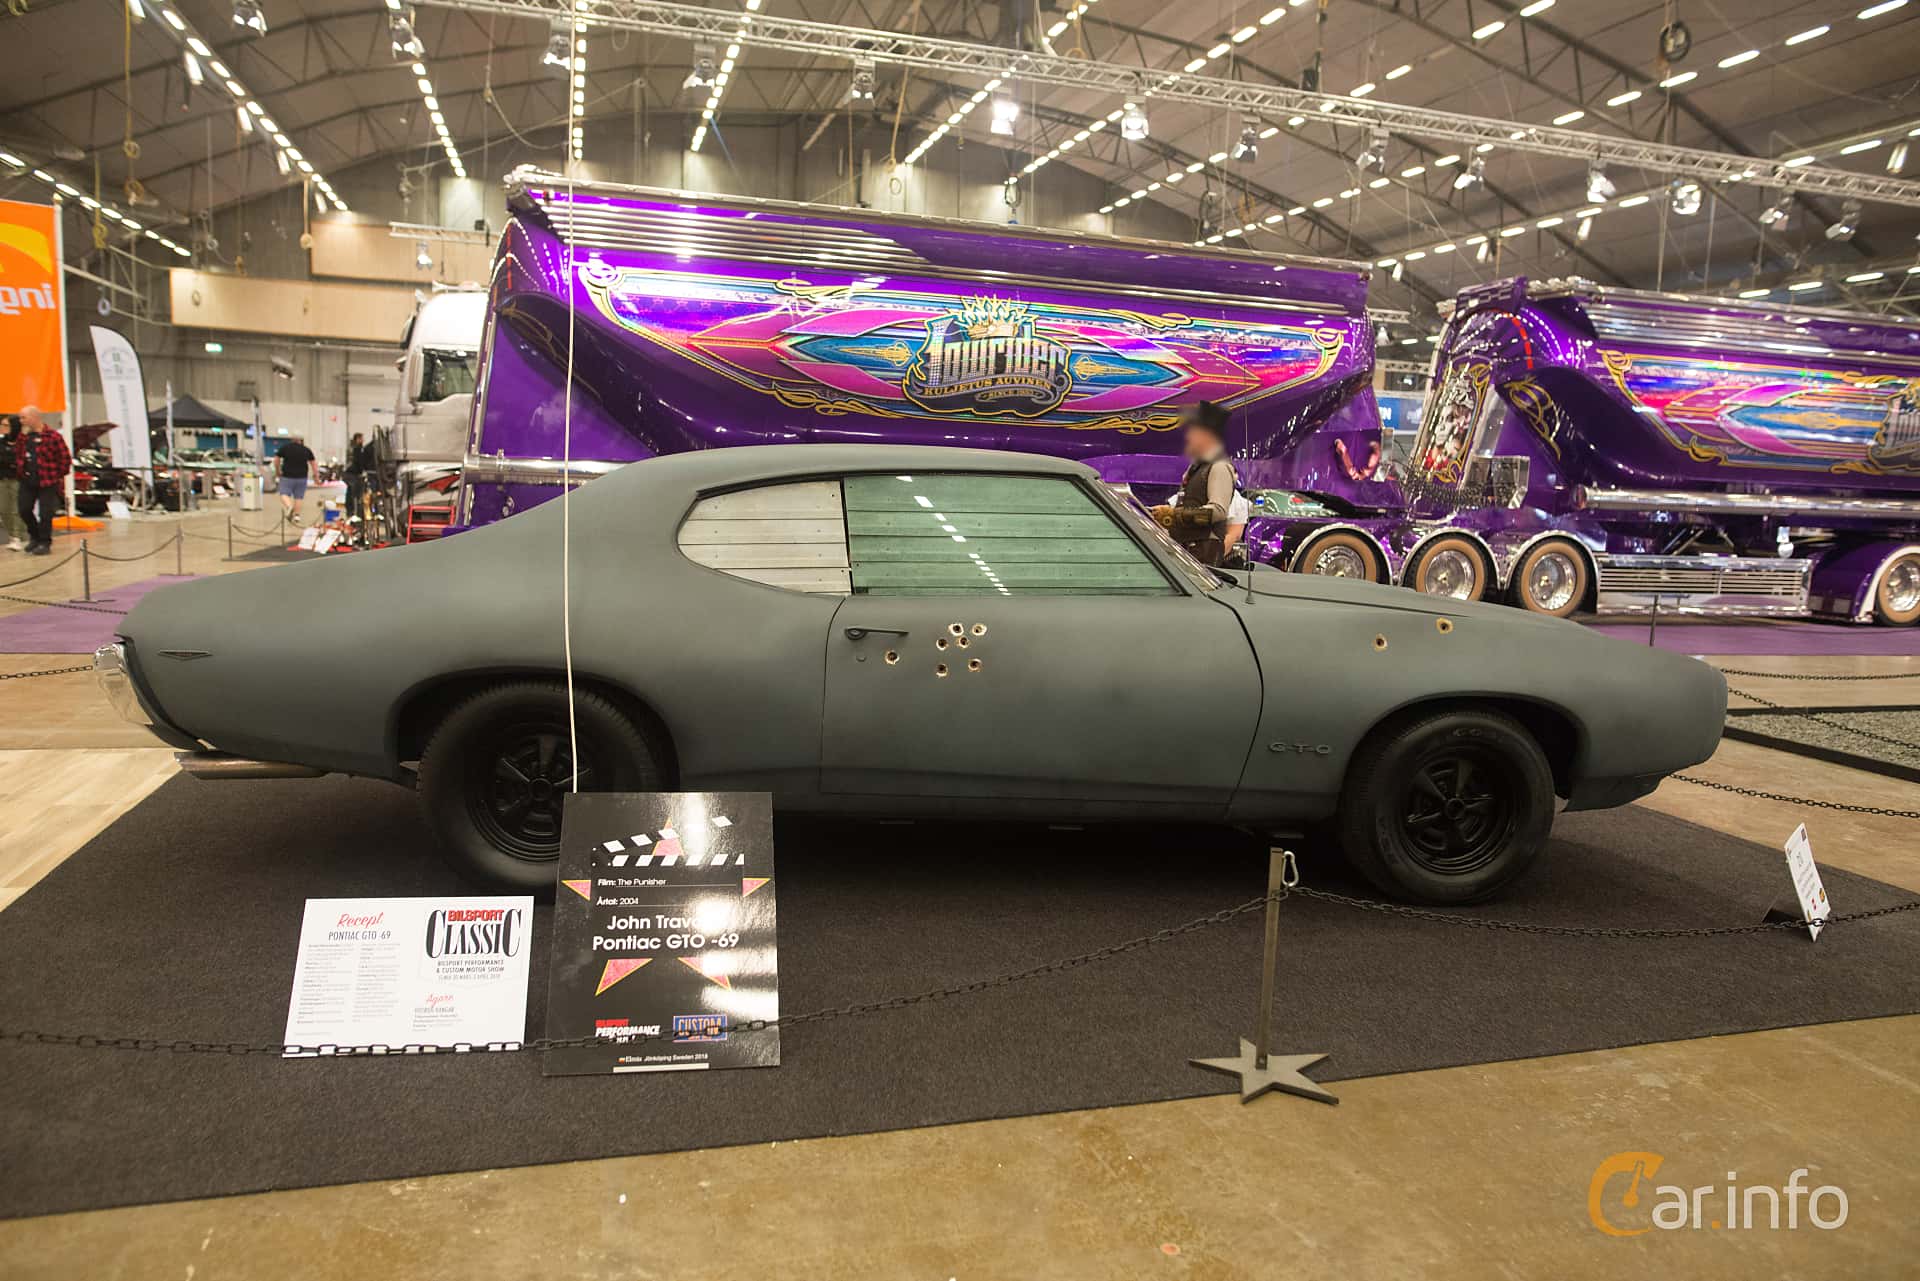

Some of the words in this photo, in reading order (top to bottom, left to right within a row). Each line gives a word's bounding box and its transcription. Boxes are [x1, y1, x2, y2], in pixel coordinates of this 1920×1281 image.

[924, 379, 993, 396] KULJETUS
[996, 375, 1052, 391] AUVINEN
[1268, 742, 1332, 755] GTO
[597, 878, 617, 887] Film:
[618, 878, 632, 886] The
[634, 877, 667, 886] Punisher
[620, 897, 639, 905] 2004
[337, 911, 384, 929] Recept
[447, 909, 505, 921] BILSPORT
[607, 915, 651, 930] John
[328, 930, 360, 941] PONTIAC
[361, 930, 377, 940] GTO
[426, 908, 522, 959] CLASSIC
[592, 935, 661, 951] Pontiac
[666, 934, 706, 949] GTO
[711, 932, 740, 949] -69
[595, 1025, 660, 1039] PERFORMANCE
